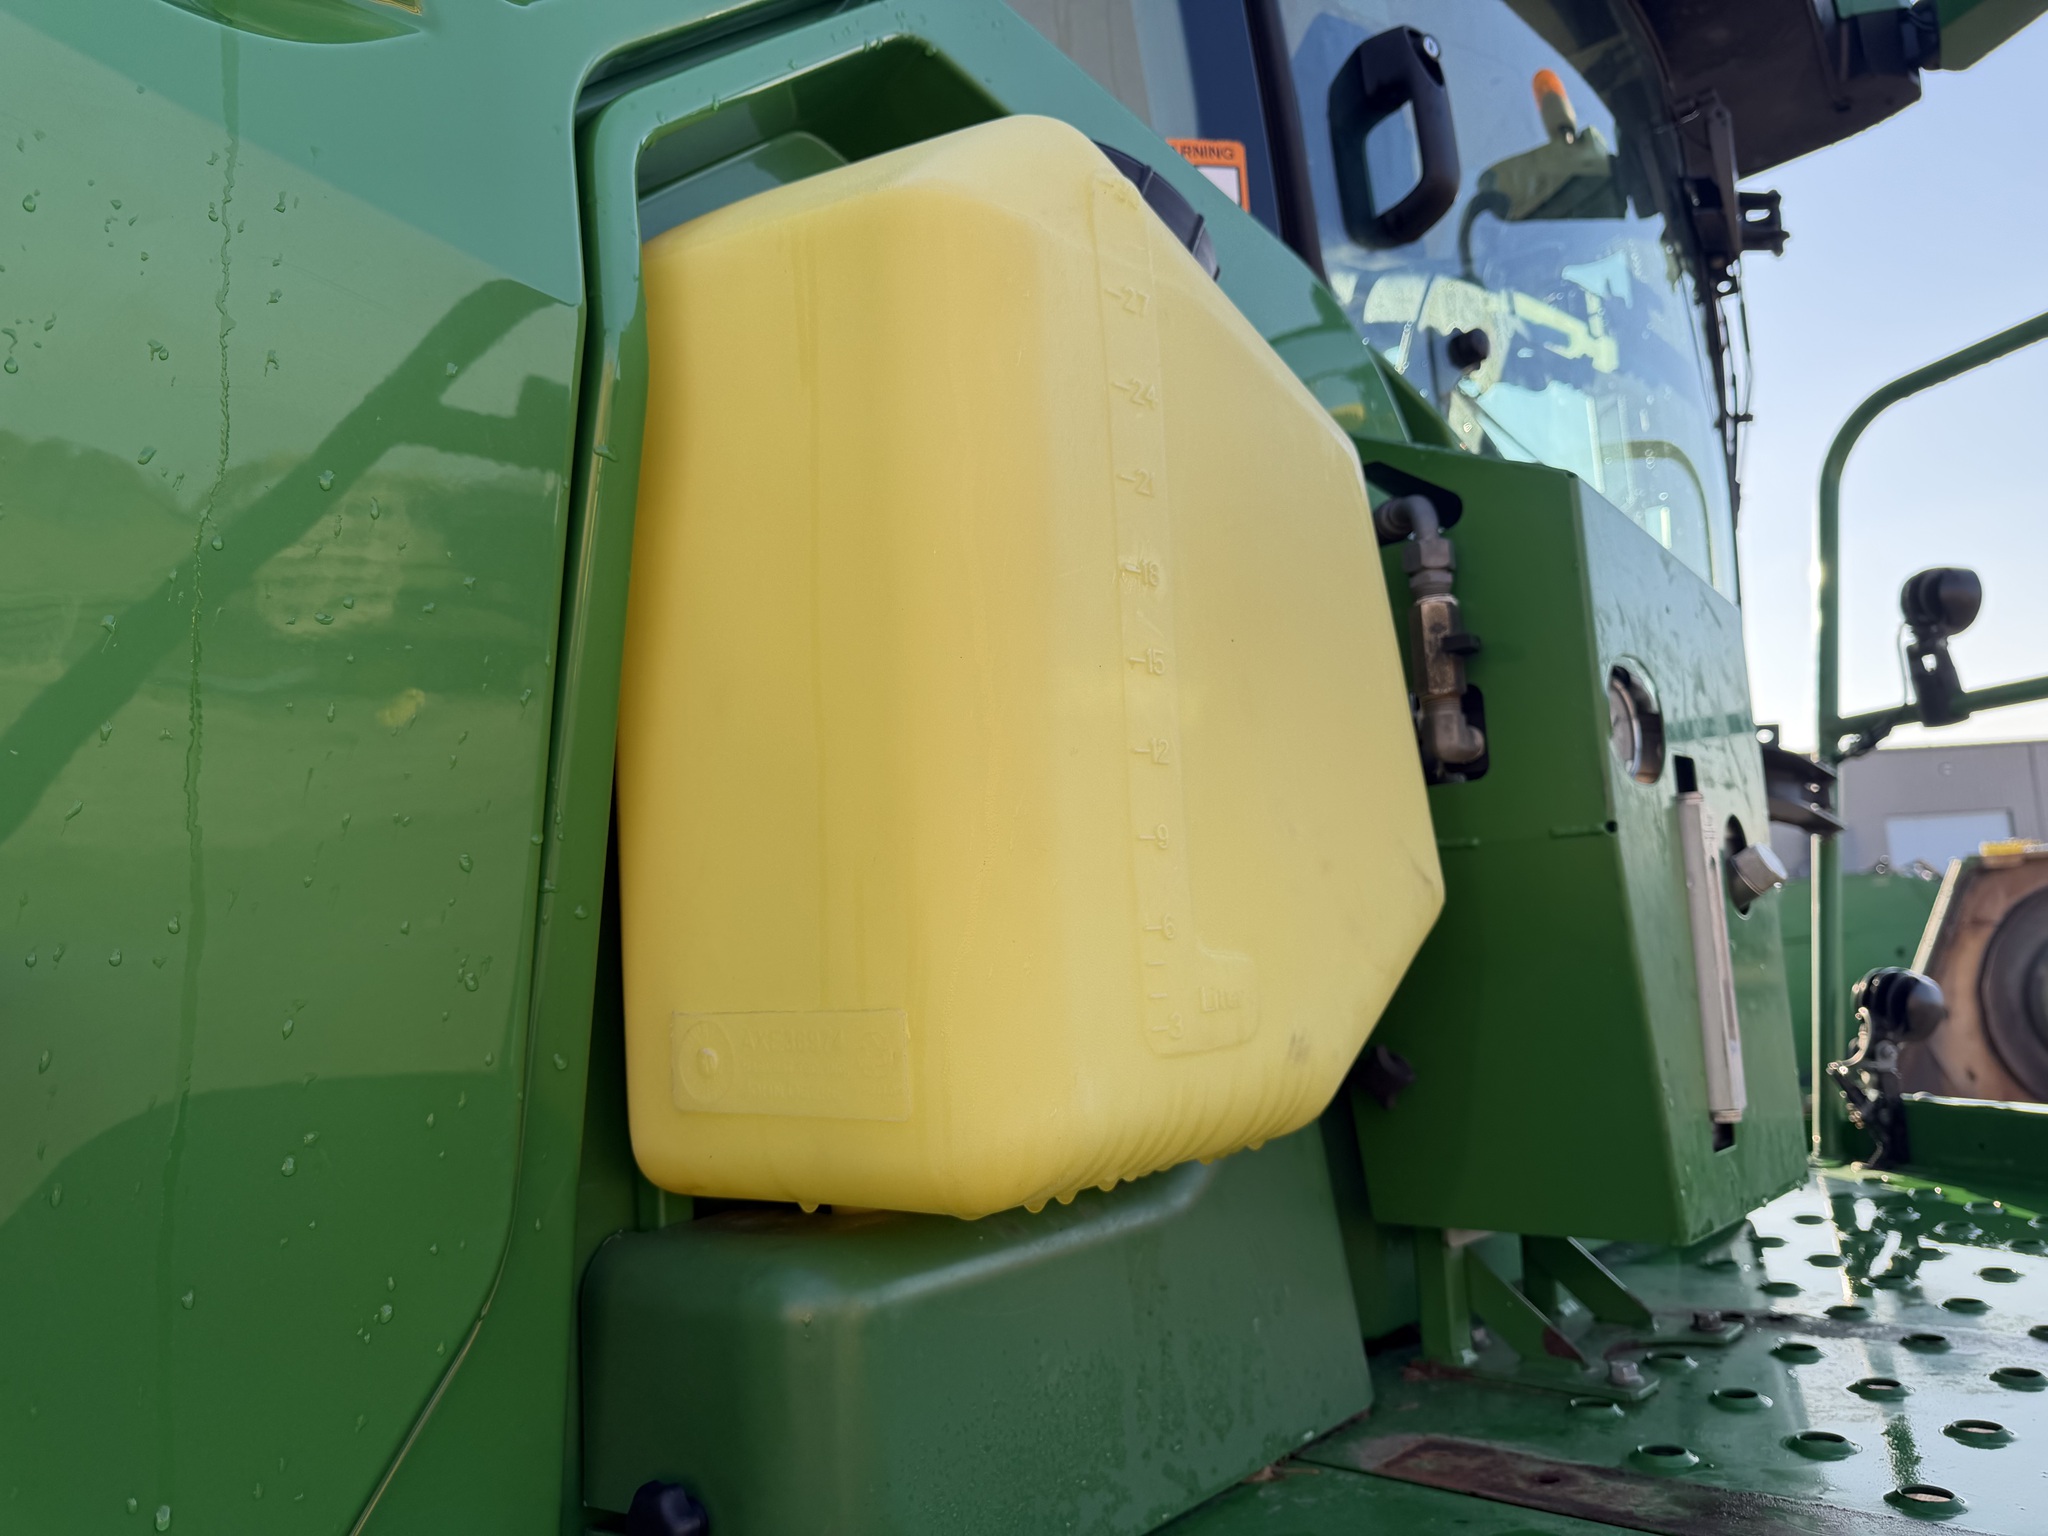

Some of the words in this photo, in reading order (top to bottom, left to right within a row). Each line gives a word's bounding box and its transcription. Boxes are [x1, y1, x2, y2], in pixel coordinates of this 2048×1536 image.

[1179, 145, 1235, 160] RNING
[1130, 378, 1158, 411] 24
[1140, 560, 1160, 588] 18
[1147, 648, 1166, 677] 15
[1151, 737, 1170, 766] 12
[1156, 823, 1169, 850] 9
[1162, 913, 1176, 941] 6
[1168, 1012, 1183, 1039] 3
